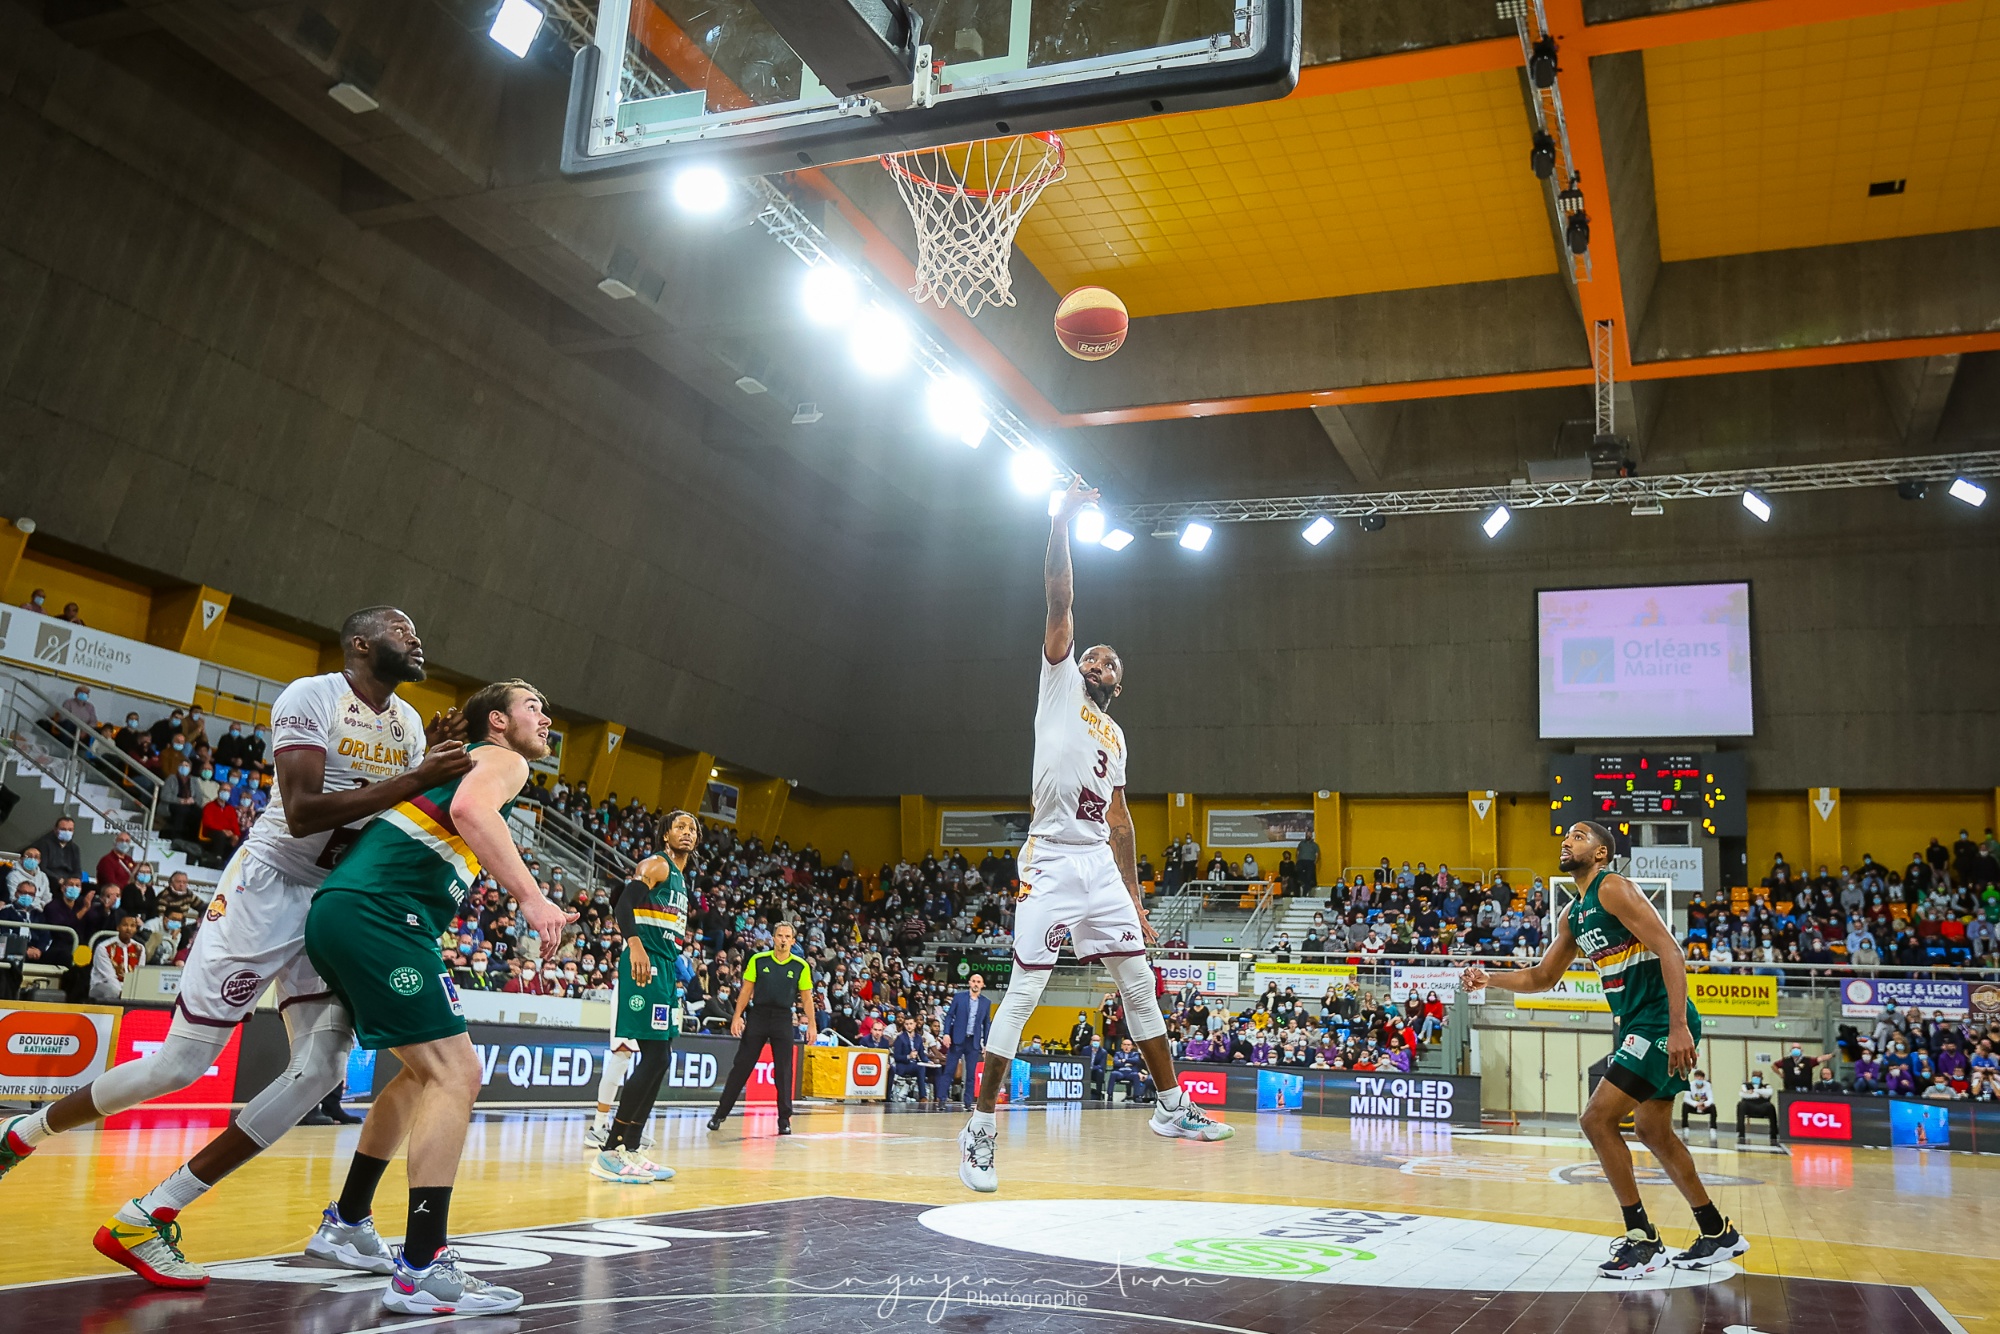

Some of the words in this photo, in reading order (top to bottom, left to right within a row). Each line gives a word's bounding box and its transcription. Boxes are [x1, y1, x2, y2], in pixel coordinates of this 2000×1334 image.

[1079, 341, 1117, 353] Betclic
[206, 606, 215, 619] 3
[74, 636, 132, 665] Orléans
[1623, 638, 1721, 660] Orléans
[72, 652, 113, 673] Mairie
[1623, 660, 1693, 677] Mairie
[338, 737, 409, 768] ORLÉANS
[350, 760, 400, 777] MÉTROPOLE
[1093, 749, 1109, 779] 3
[1478, 802, 1485, 811] 6
[1822, 802, 1829, 812] 7
[1636, 855, 1697, 870] Orléans
[1636, 869, 1679, 881] Mairie
[393, 972, 419, 988] CSP
[1696, 984, 1769, 998] BOURDIN
[1877, 982, 1911, 994] ROSE
[1913, 983, 1926, 994] &
[1927, 984, 1962, 997] LEON
[19, 1035, 70, 1046] BOUYGUES
[23, 1045, 63, 1054] BATIMENT
[507, 1045, 593, 1089] QLED
[668, 1052, 718, 1088] LED
[1049, 1061, 1061, 1080] TV
[1062, 1062, 1084, 1079] QLED
[28, 1085, 80, 1095] SUD-OUEST
[1047, 1081, 1066, 1098] MINI
[1066, 1081, 1083, 1099] LED
[1183, 1080, 1219, 1095] TCL
[1355, 1077, 1386, 1097] TV
[1391, 1080, 1454, 1100] QLED
[1350, 1096, 1401, 1116] MINI
[1406, 1099, 1453, 1119] LED
[1797, 1112, 1842, 1128] TCL
